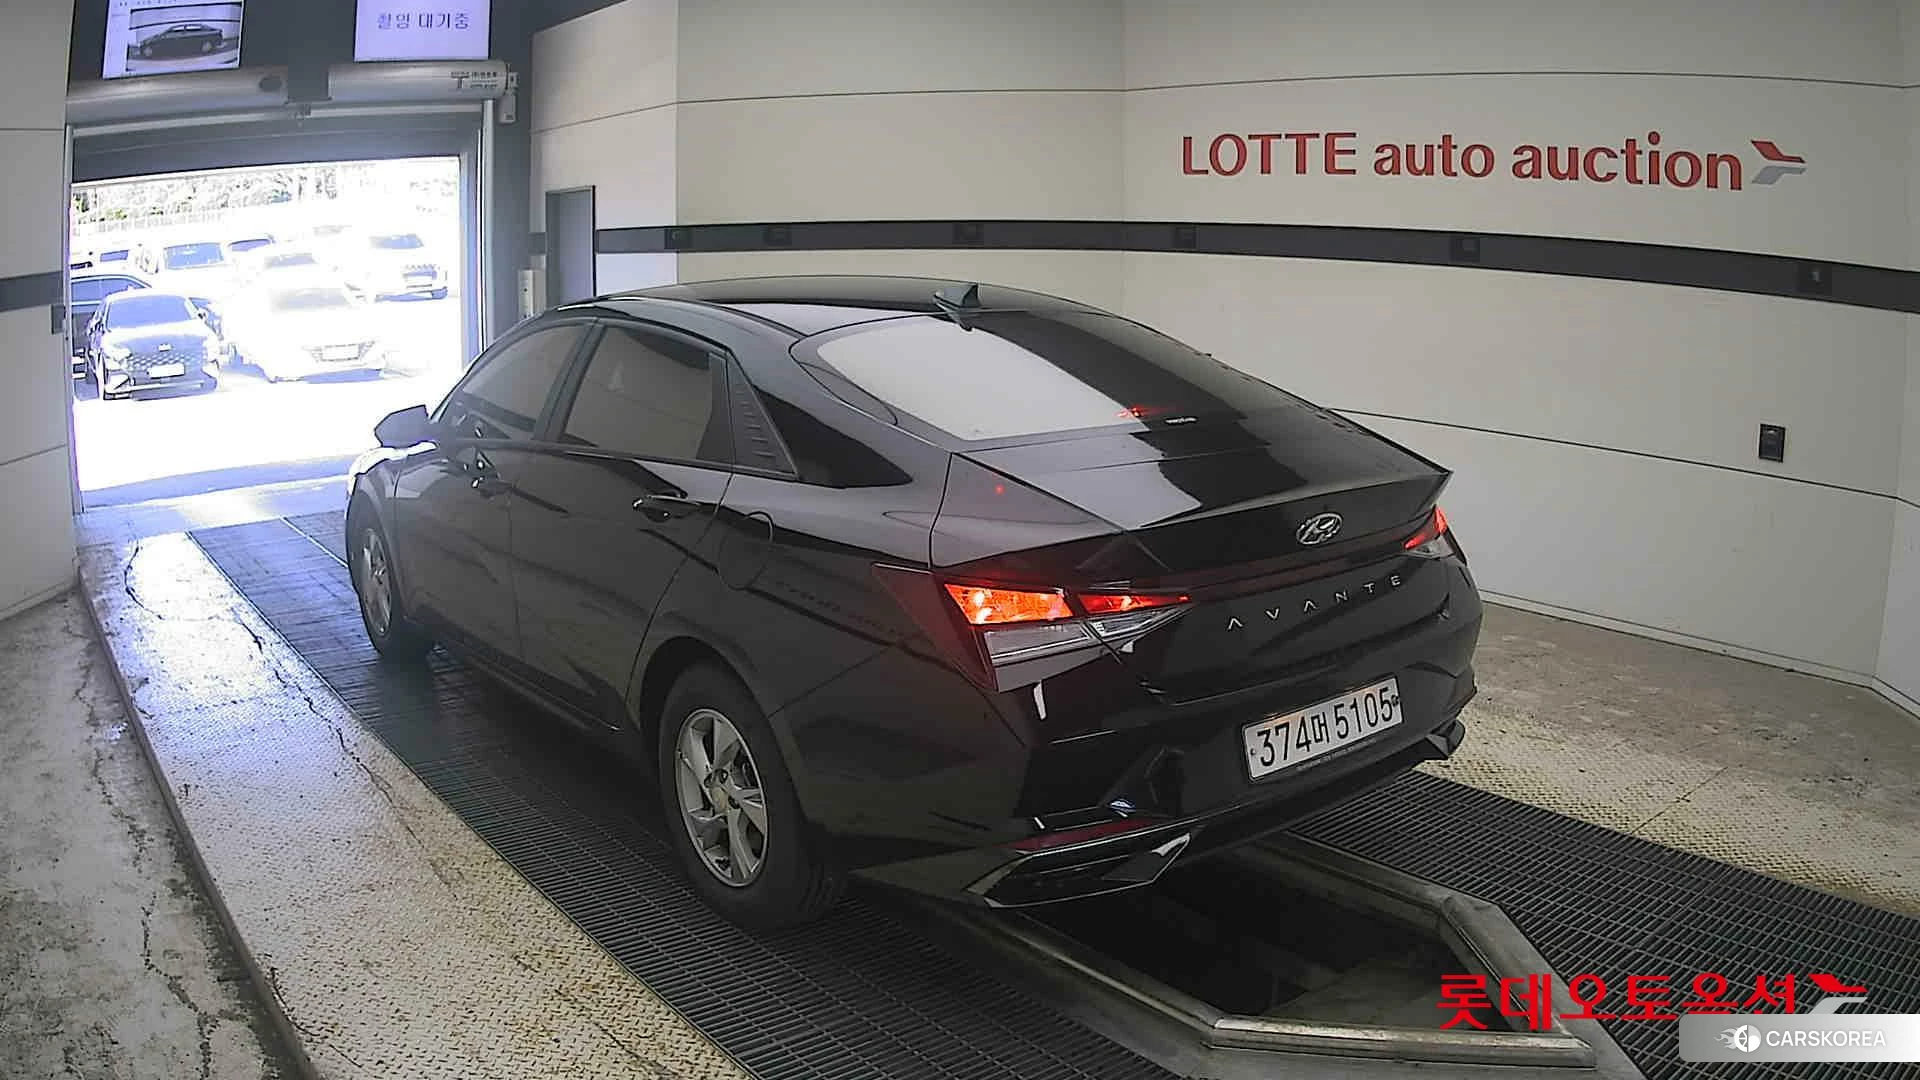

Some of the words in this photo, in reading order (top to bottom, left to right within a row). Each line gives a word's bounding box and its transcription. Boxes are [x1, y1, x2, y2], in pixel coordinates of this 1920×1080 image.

[418, 12, 469, 30] 대기중
[1182, 132, 1357, 176] LOTTE
[1373, 134, 1496, 178] auto
[1511, 131, 1743, 191] auction
[1226, 575, 1402, 632] AVANTE
